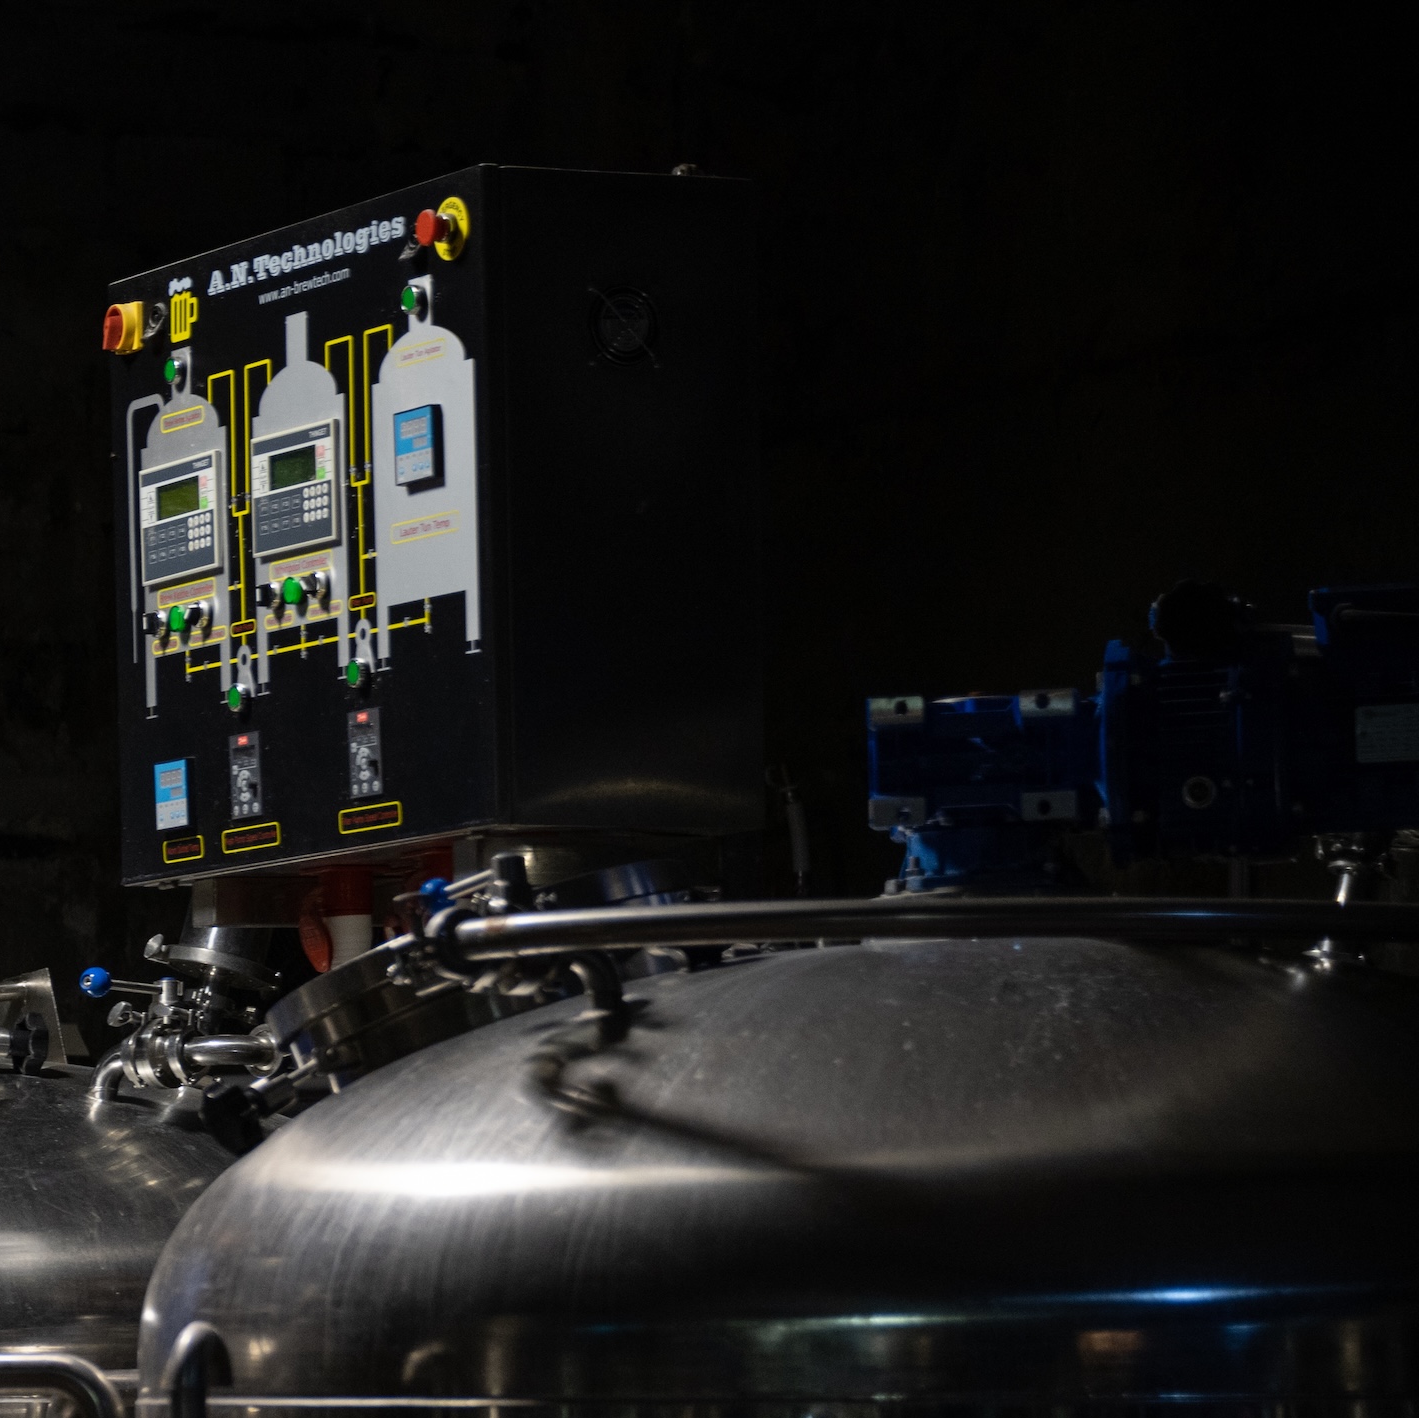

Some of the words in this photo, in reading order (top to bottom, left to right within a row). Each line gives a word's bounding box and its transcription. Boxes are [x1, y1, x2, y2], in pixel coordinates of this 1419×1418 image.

[258, 267, 351, 305] www.an-brewtech.com
[400, 526, 419, 537] Lauter
[420, 523, 431, 531] Tun
[433, 520, 450, 529] Temp
